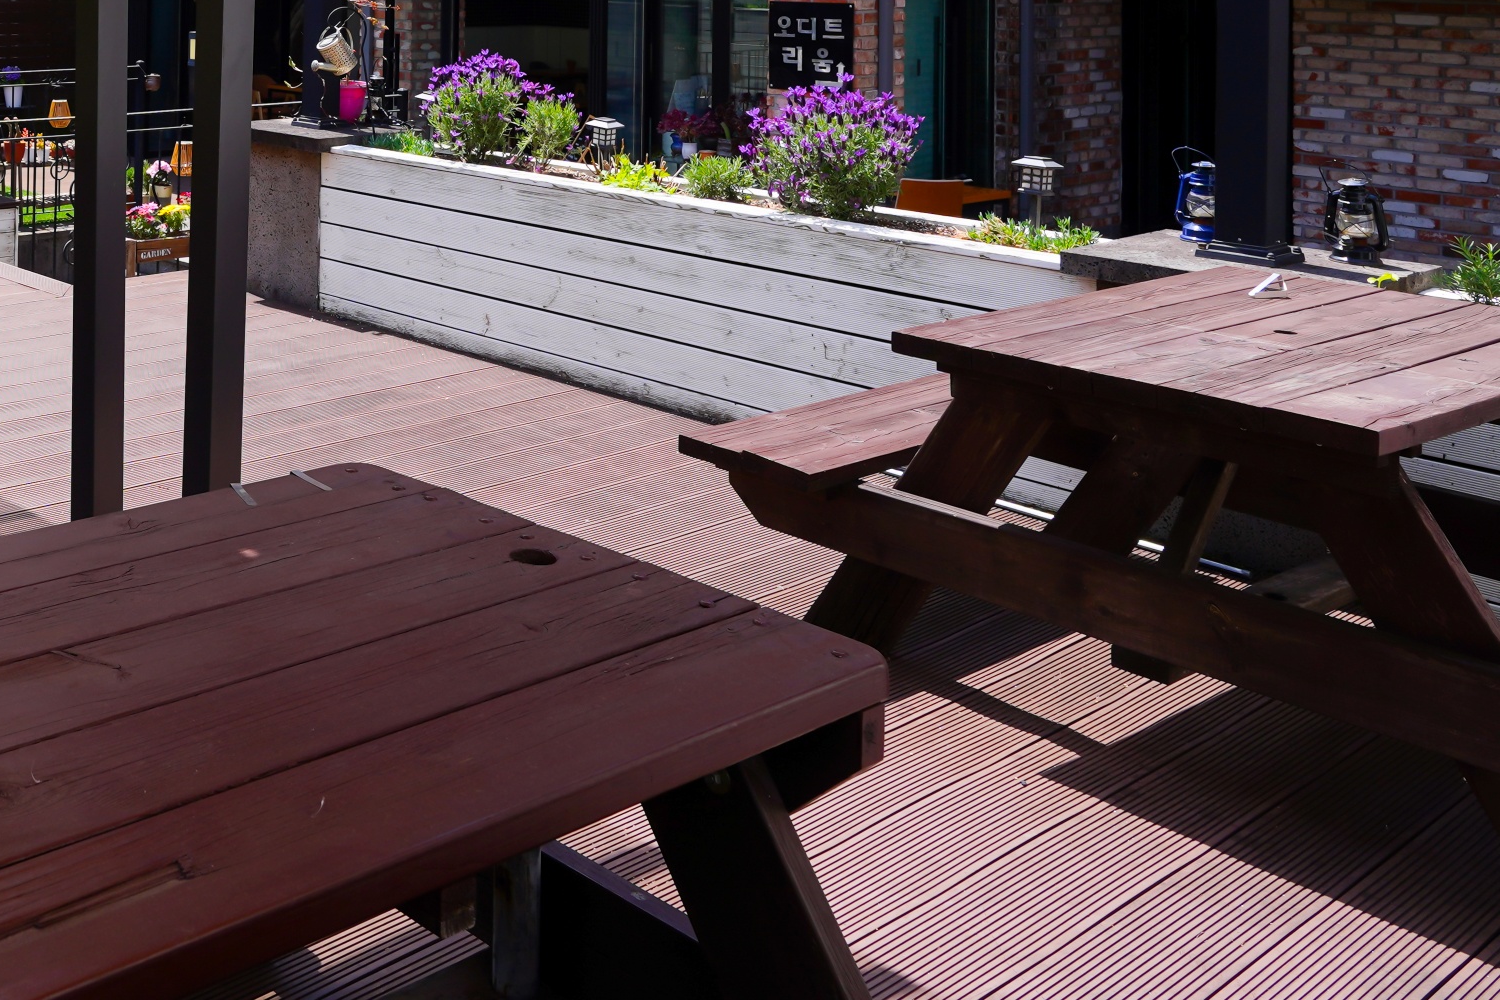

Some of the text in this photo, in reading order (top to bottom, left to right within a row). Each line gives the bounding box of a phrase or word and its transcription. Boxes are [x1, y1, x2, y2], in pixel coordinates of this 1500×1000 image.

[774, 16, 845, 40] 오디트
[782, 46, 834, 73] 리움
[141, 248, 172, 259] GARDEN
